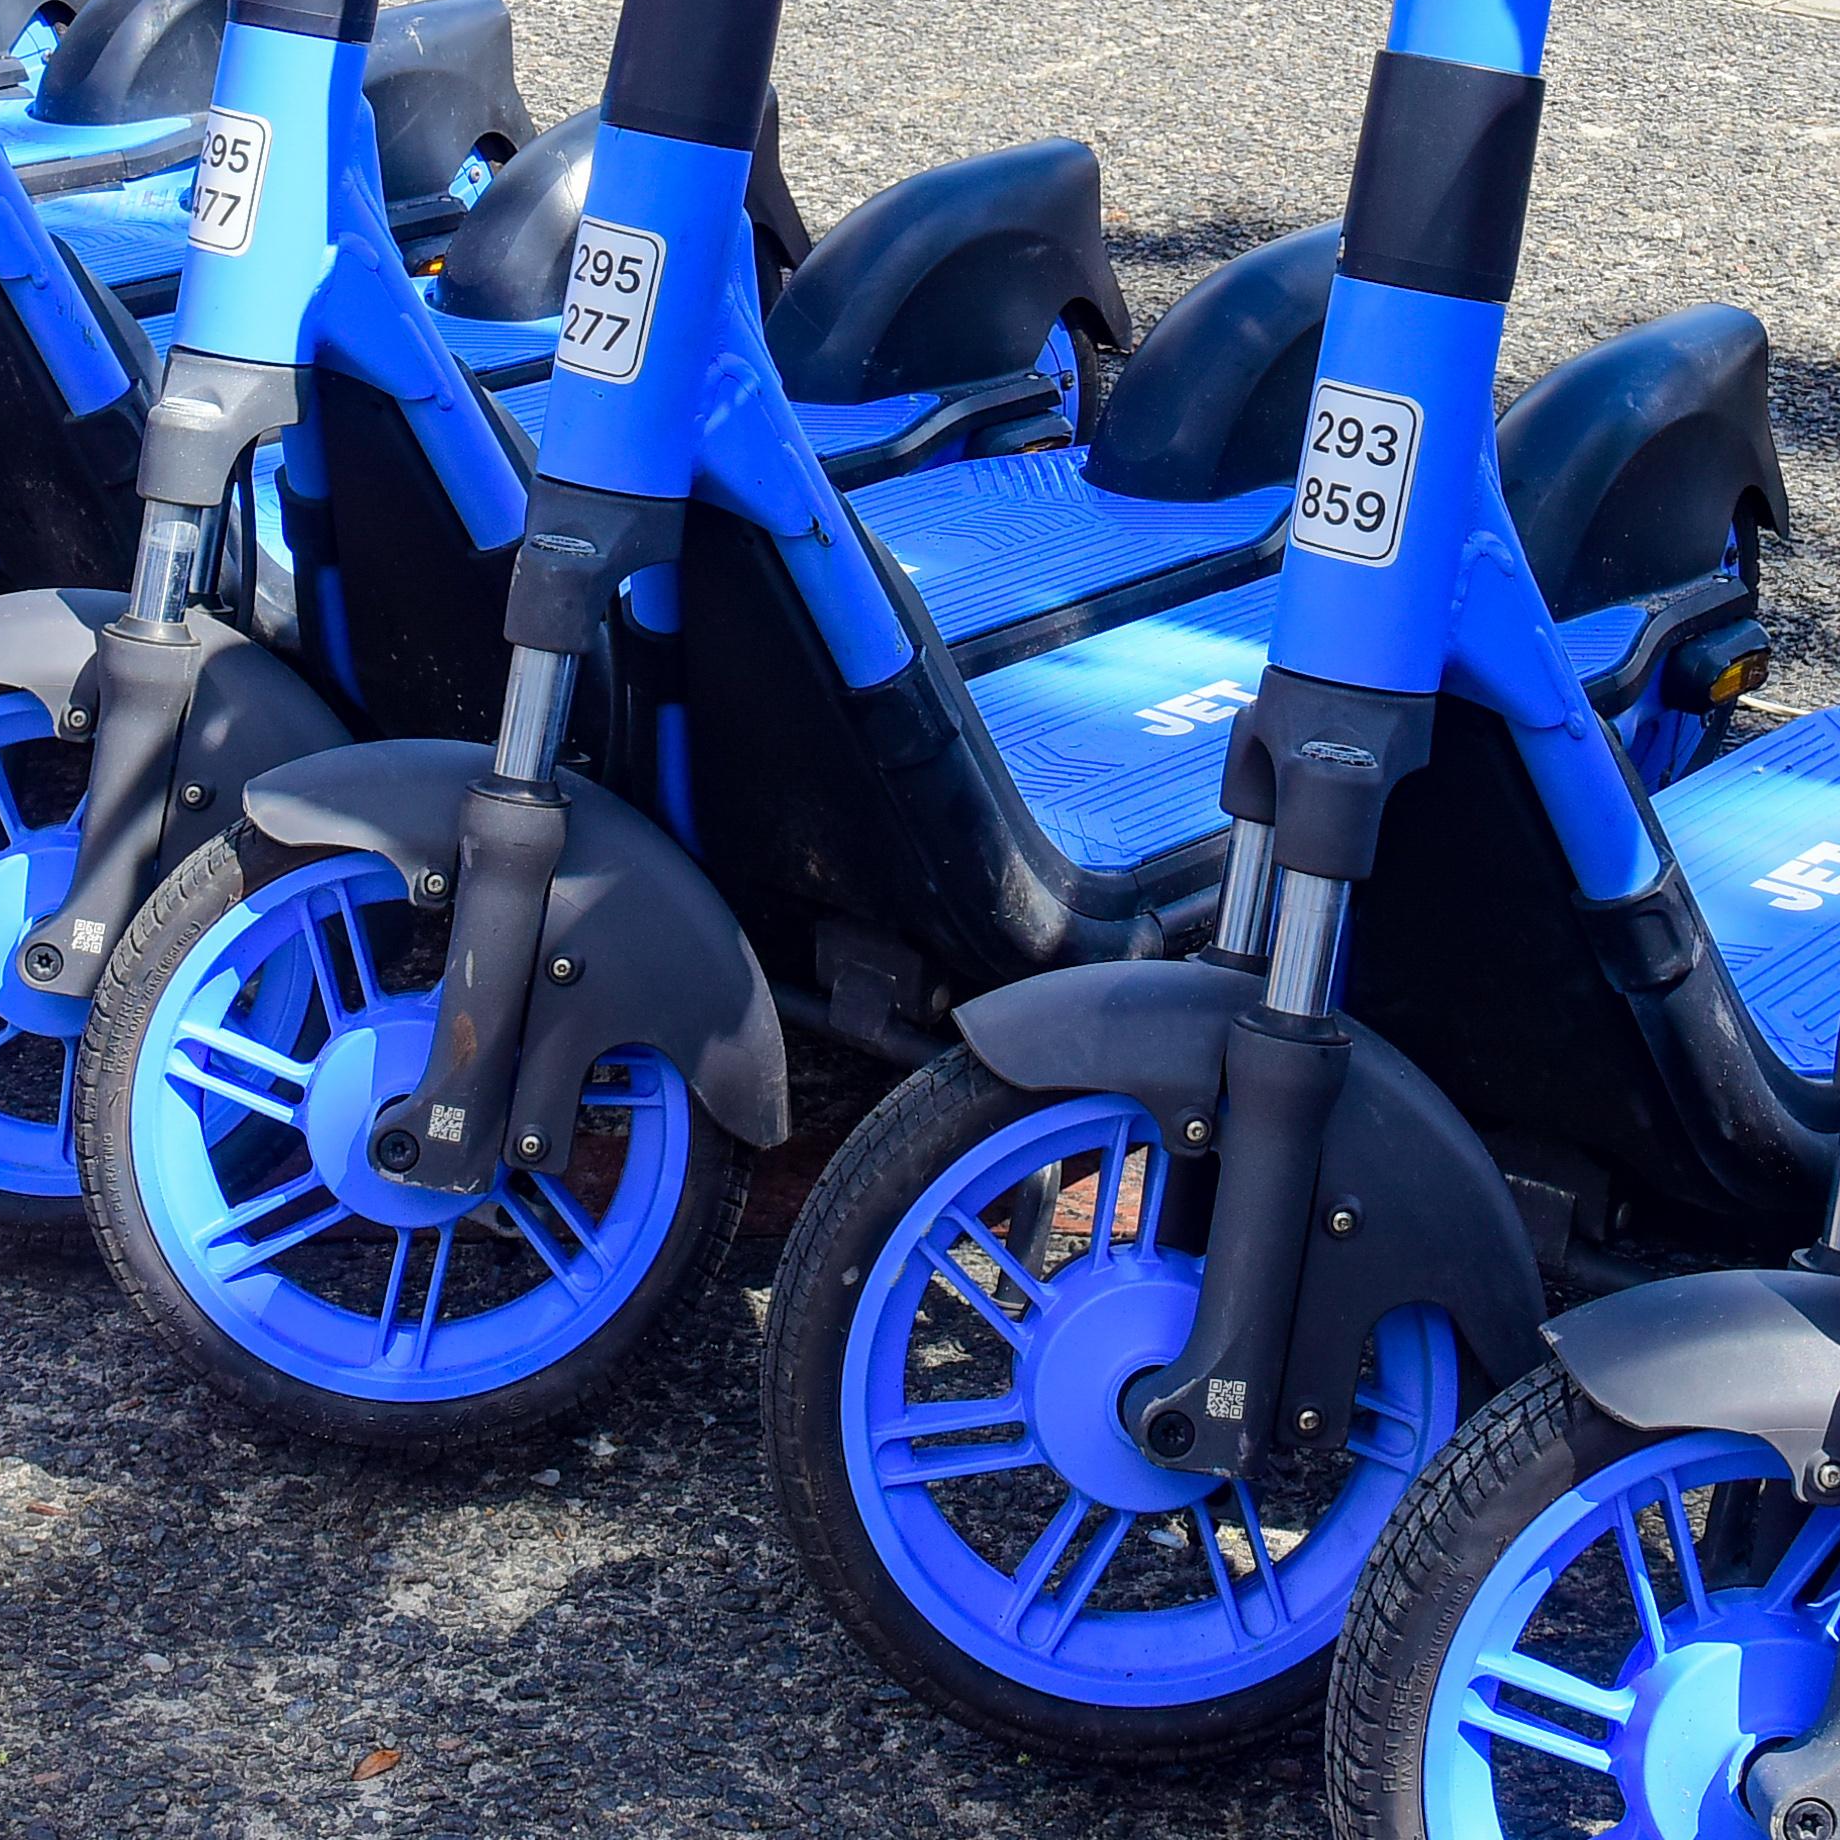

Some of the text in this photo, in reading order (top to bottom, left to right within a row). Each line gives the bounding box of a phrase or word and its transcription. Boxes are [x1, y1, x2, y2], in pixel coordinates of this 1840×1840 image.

[201, 129, 252, 174] 295
[571, 241, 643, 297] 295
[561, 301, 633, 354] 277
[1310, 409, 1399, 469] 293
[1300, 474, 1387, 535] 859
[1133, 678, 1258, 737] JET
